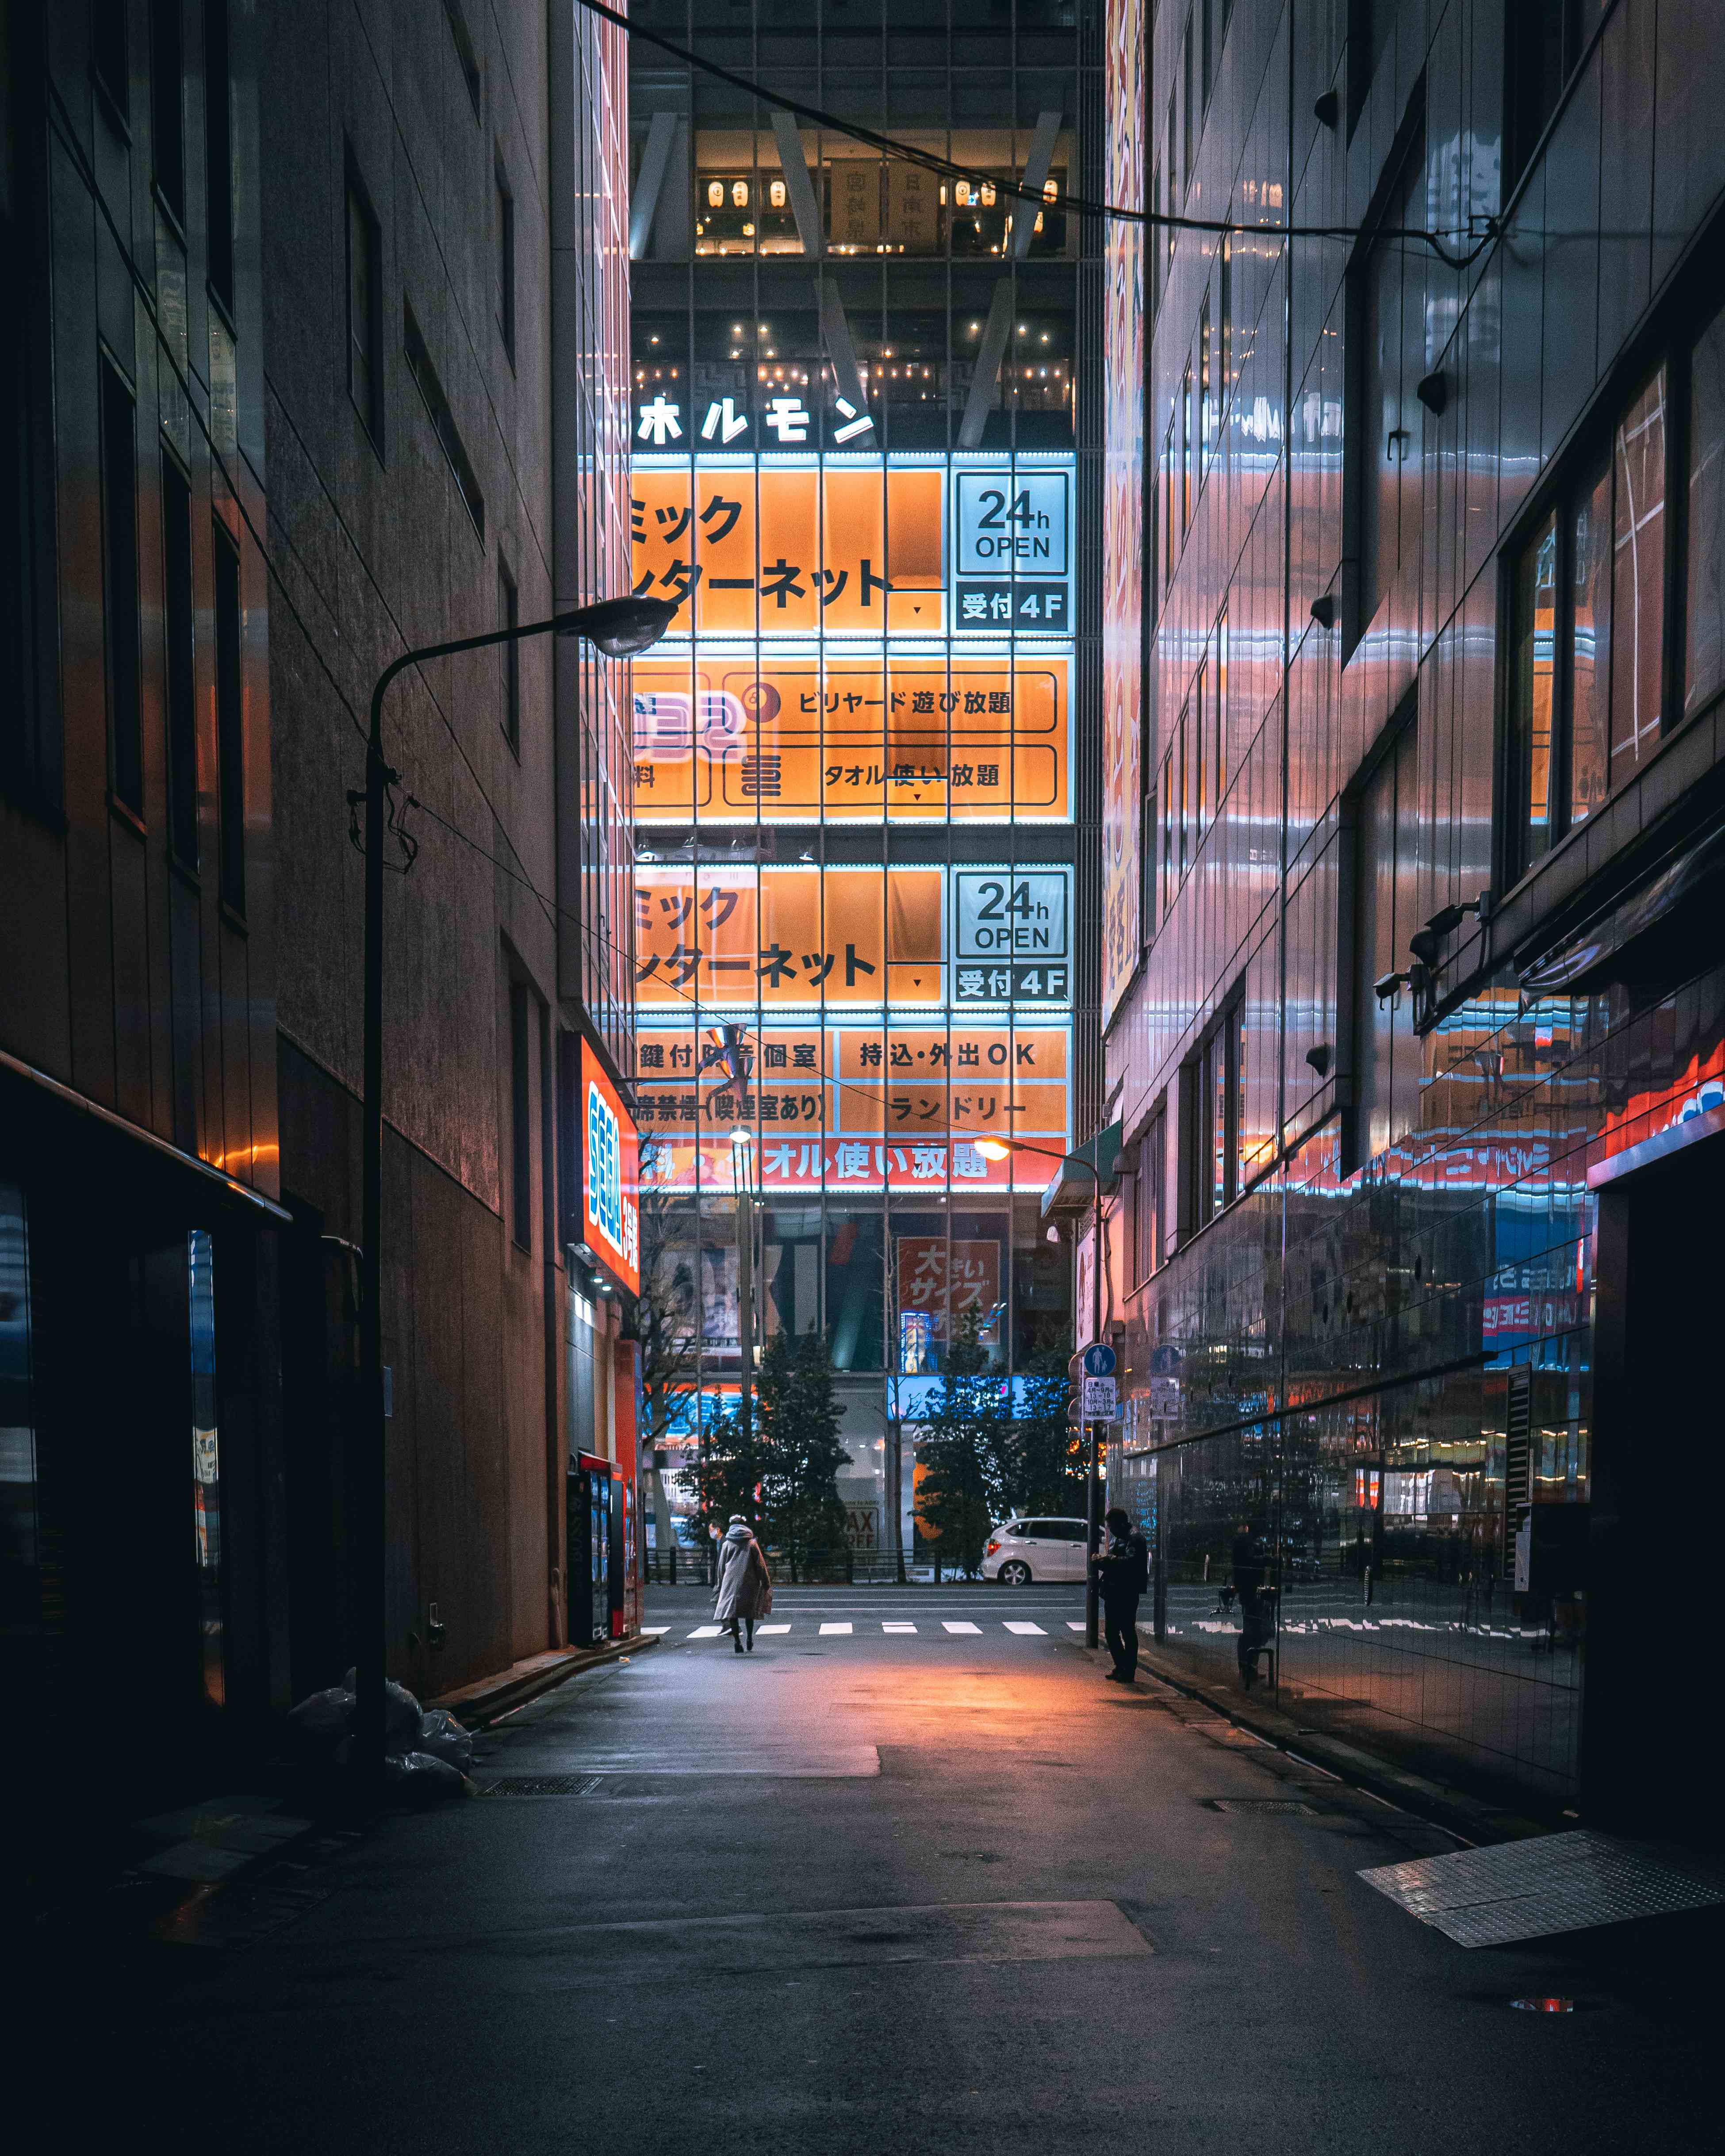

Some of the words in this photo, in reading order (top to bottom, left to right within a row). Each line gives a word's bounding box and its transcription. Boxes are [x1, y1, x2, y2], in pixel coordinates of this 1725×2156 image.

[637, 396, 874, 444] ホルモン
[978, 489, 1050, 529] 24h
[976, 536, 1050, 558] OPEN
[962, 593, 1062, 620] 受付4F
[800, 691, 1011, 714] ビリヤード遊び放題
[824, 764, 1000, 787] タオル使い放題
[977, 881, 1049, 920] 24h
[975, 927, 1049, 949] OPEN
[959, 969, 1065, 998] 受付4F
[860, 1042, 1035, 1066] 持込・外出OK
[891, 1097, 1026, 1120] ランドリー
[588, 1080, 623, 1257] SEGA
[847, 1511, 874, 1532] AX
